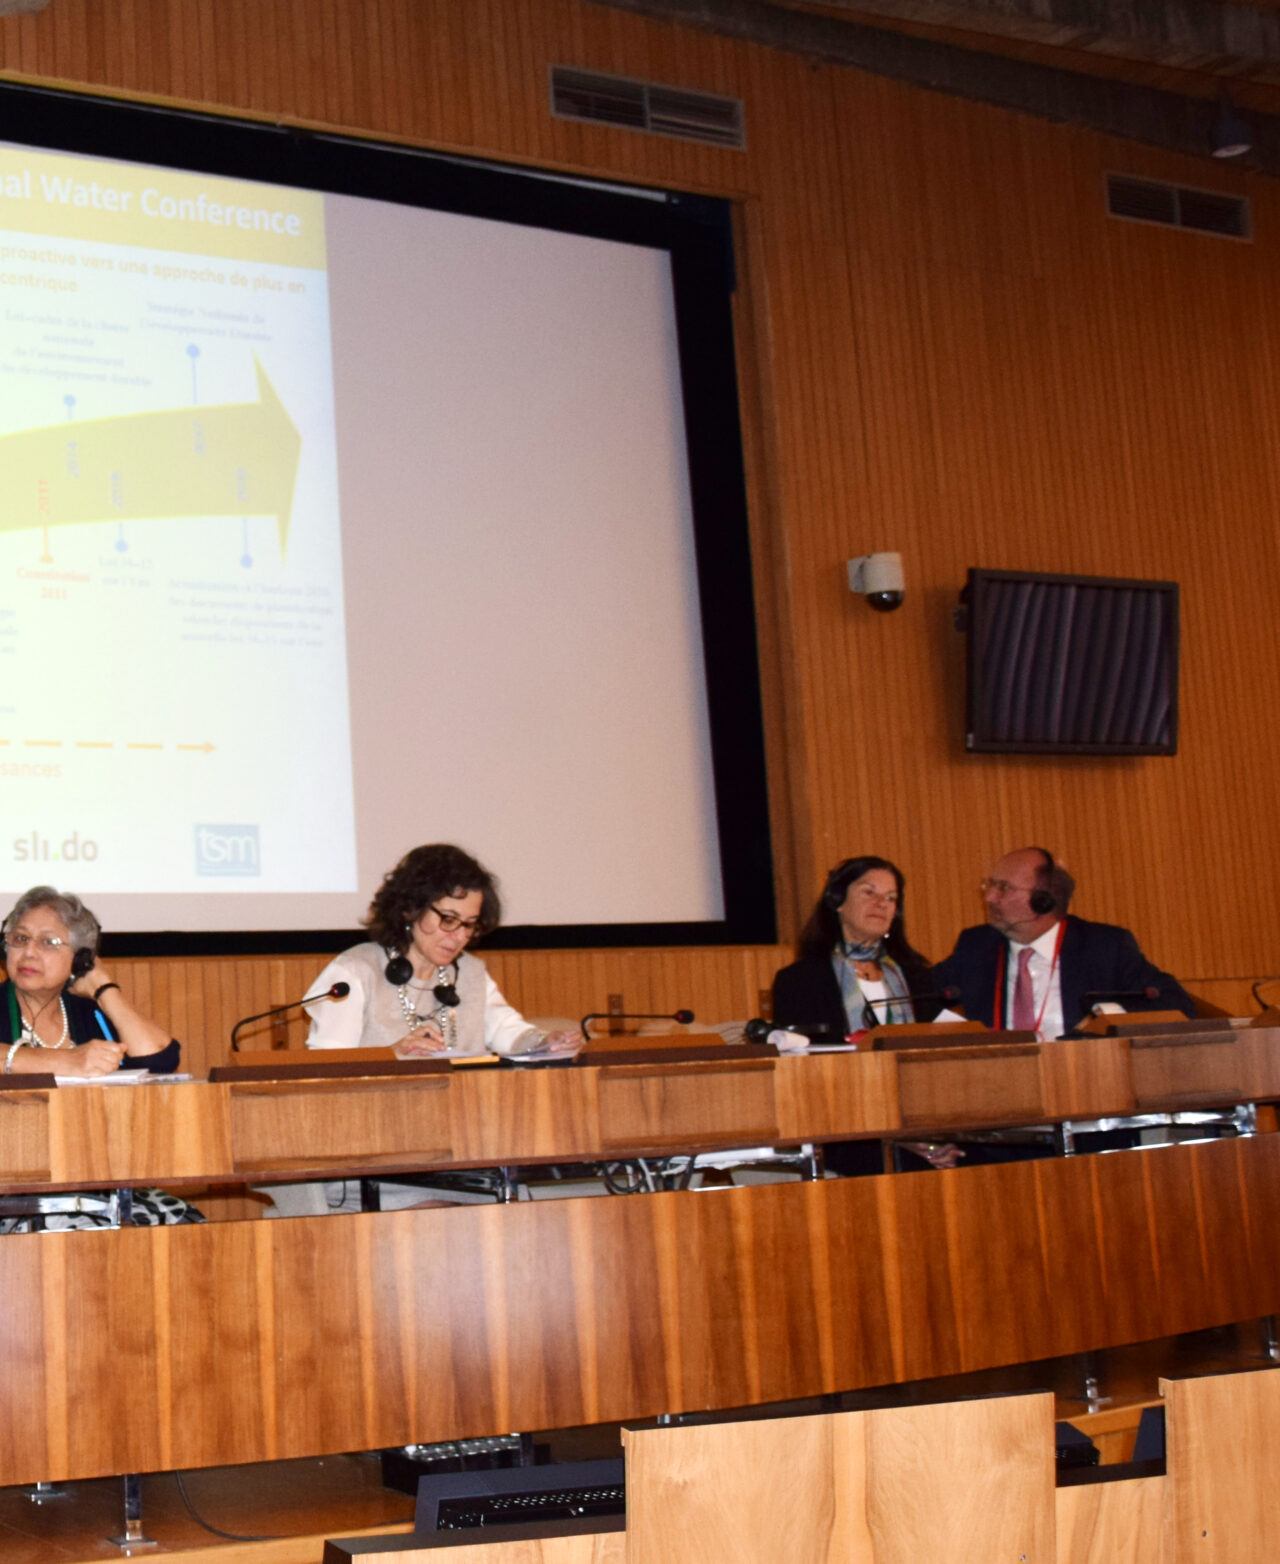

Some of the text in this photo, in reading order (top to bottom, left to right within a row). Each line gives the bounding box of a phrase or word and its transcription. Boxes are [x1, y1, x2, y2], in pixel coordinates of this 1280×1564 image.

[39, 174, 133, 213] Water
[140, 187, 303, 236] Conference
[0, 241, 77, 271] proactive
[80, 252, 116, 272] vers
[118, 257, 150, 276] une
[152, 260, 226, 288] approche
[228, 270, 250, 289] de
[252, 272, 284, 297] plus
[286, 281, 307, 295] en
[198, 827, 257, 864] tsm
